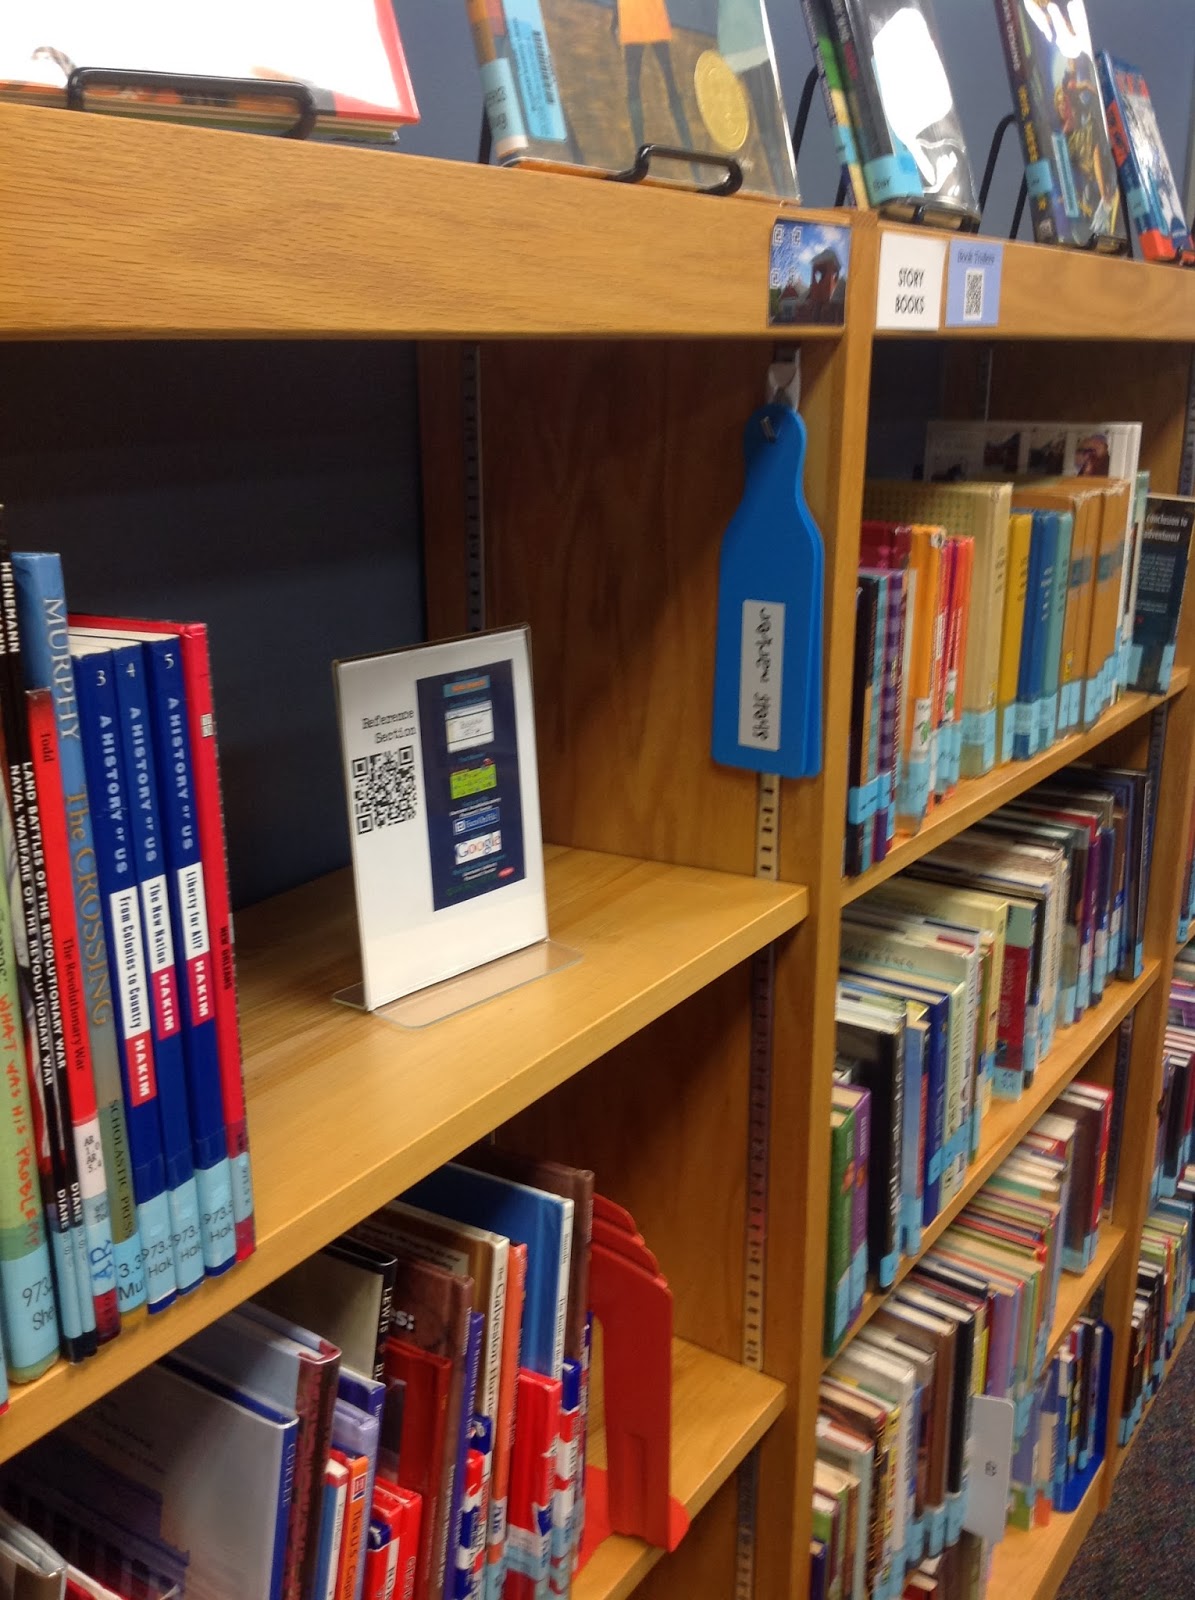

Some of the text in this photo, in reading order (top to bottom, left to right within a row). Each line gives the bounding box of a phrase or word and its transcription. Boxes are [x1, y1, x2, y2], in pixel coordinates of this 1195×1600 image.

[898, 267, 925, 288] STORY
[895, 294, 925, 315] BOOKS
[1, 561, 20, 653] HEINEMANN
[45, 599, 80, 740] MURPHY
[96, 669, 107, 688] 3
[125, 661, 137, 679] 4
[164, 652, 174, 670] 5
[99, 715, 112, 729] A
[129, 706, 141, 720] A
[168, 697, 180, 710] A
[361, 709, 415, 730] Reference
[374, 726, 417, 744] Section
[102, 732, 123, 821] HISTORY
[131, 723, 152, 810] HISTORY
[169, 714, 189, 800] HISTORY
[144, 837, 157, 862] US
[181, 825, 194, 850] US
[456, 833, 502, 859] Google
[114, 849, 128, 874] US
[66, 789, 111, 1026] The CROSSING
[185, 871, 198, 909] Liberty
[10, 764, 53, 1086] NAVAL WARFARE OF THE REVOLUTIONARY WAR
[22, 760, 66, 1070] LAND BATTLES OF THE REVOLUTIONARY WAR
[149, 881, 166, 965] The New Nation
[119, 895, 142, 1029] From Colonies to Country
[62, 935, 85, 1071] The Revolutionary War
[158, 972, 174, 1032] HAKIM
[194, 960, 209, 1017] HAKIM
[0, 993, 18, 1052] WHAT
[6, 1060, 22, 1098] WAS
[134, 1038, 150, 1098] HAKIM
[11, 1105, 27, 1135] HIS
[110, 1098, 128, 1188] SCHOLASTIC
[57, 1188, 70, 1230] DIANE
[70, 1181, 82, 1224] DIANE
[148, 1256, 174, 1279] Hak
[117, 1280, 144, 1301] Mu
[489, 1281, 505, 1364] Galveston
[486, 1365, 500, 1415] Hurric
